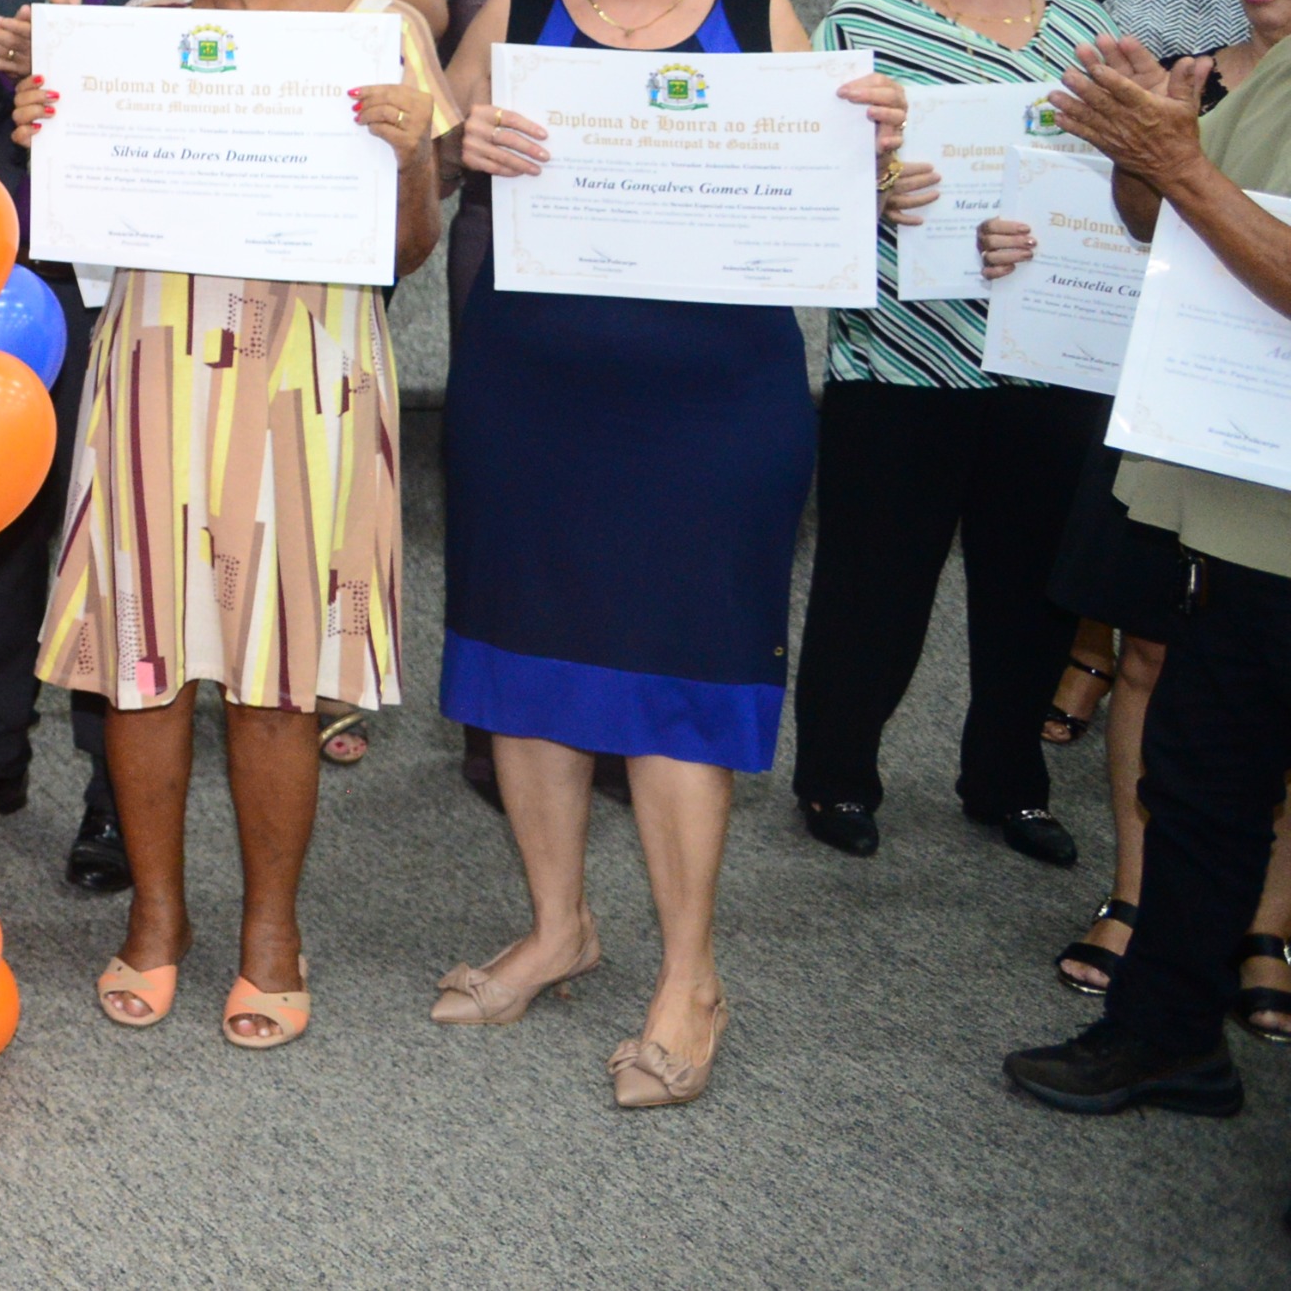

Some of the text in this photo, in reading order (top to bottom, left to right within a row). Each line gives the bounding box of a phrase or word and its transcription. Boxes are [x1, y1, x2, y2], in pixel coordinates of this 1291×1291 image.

[81, 75, 343, 98] Diploma de Honra ao Mérito
[115, 99, 163, 111] Câmara
[167, 100, 231, 115] Municipal
[547, 110, 821, 134] Diploma de Honra ao Mérito
[582, 133, 780, 151] Câmara Municipal de Goiânia
[943, 143, 1004, 158] Diploma
[111, 144, 308, 164] Silvia das Dores Damasceno
[573, 176, 793, 197] Maria Gonçalves Gomes Lima
[955, 198, 1002, 210] Maria d
[1049, 211, 1124, 237] Diploma
[1046, 273, 1113, 294] Auristelia
